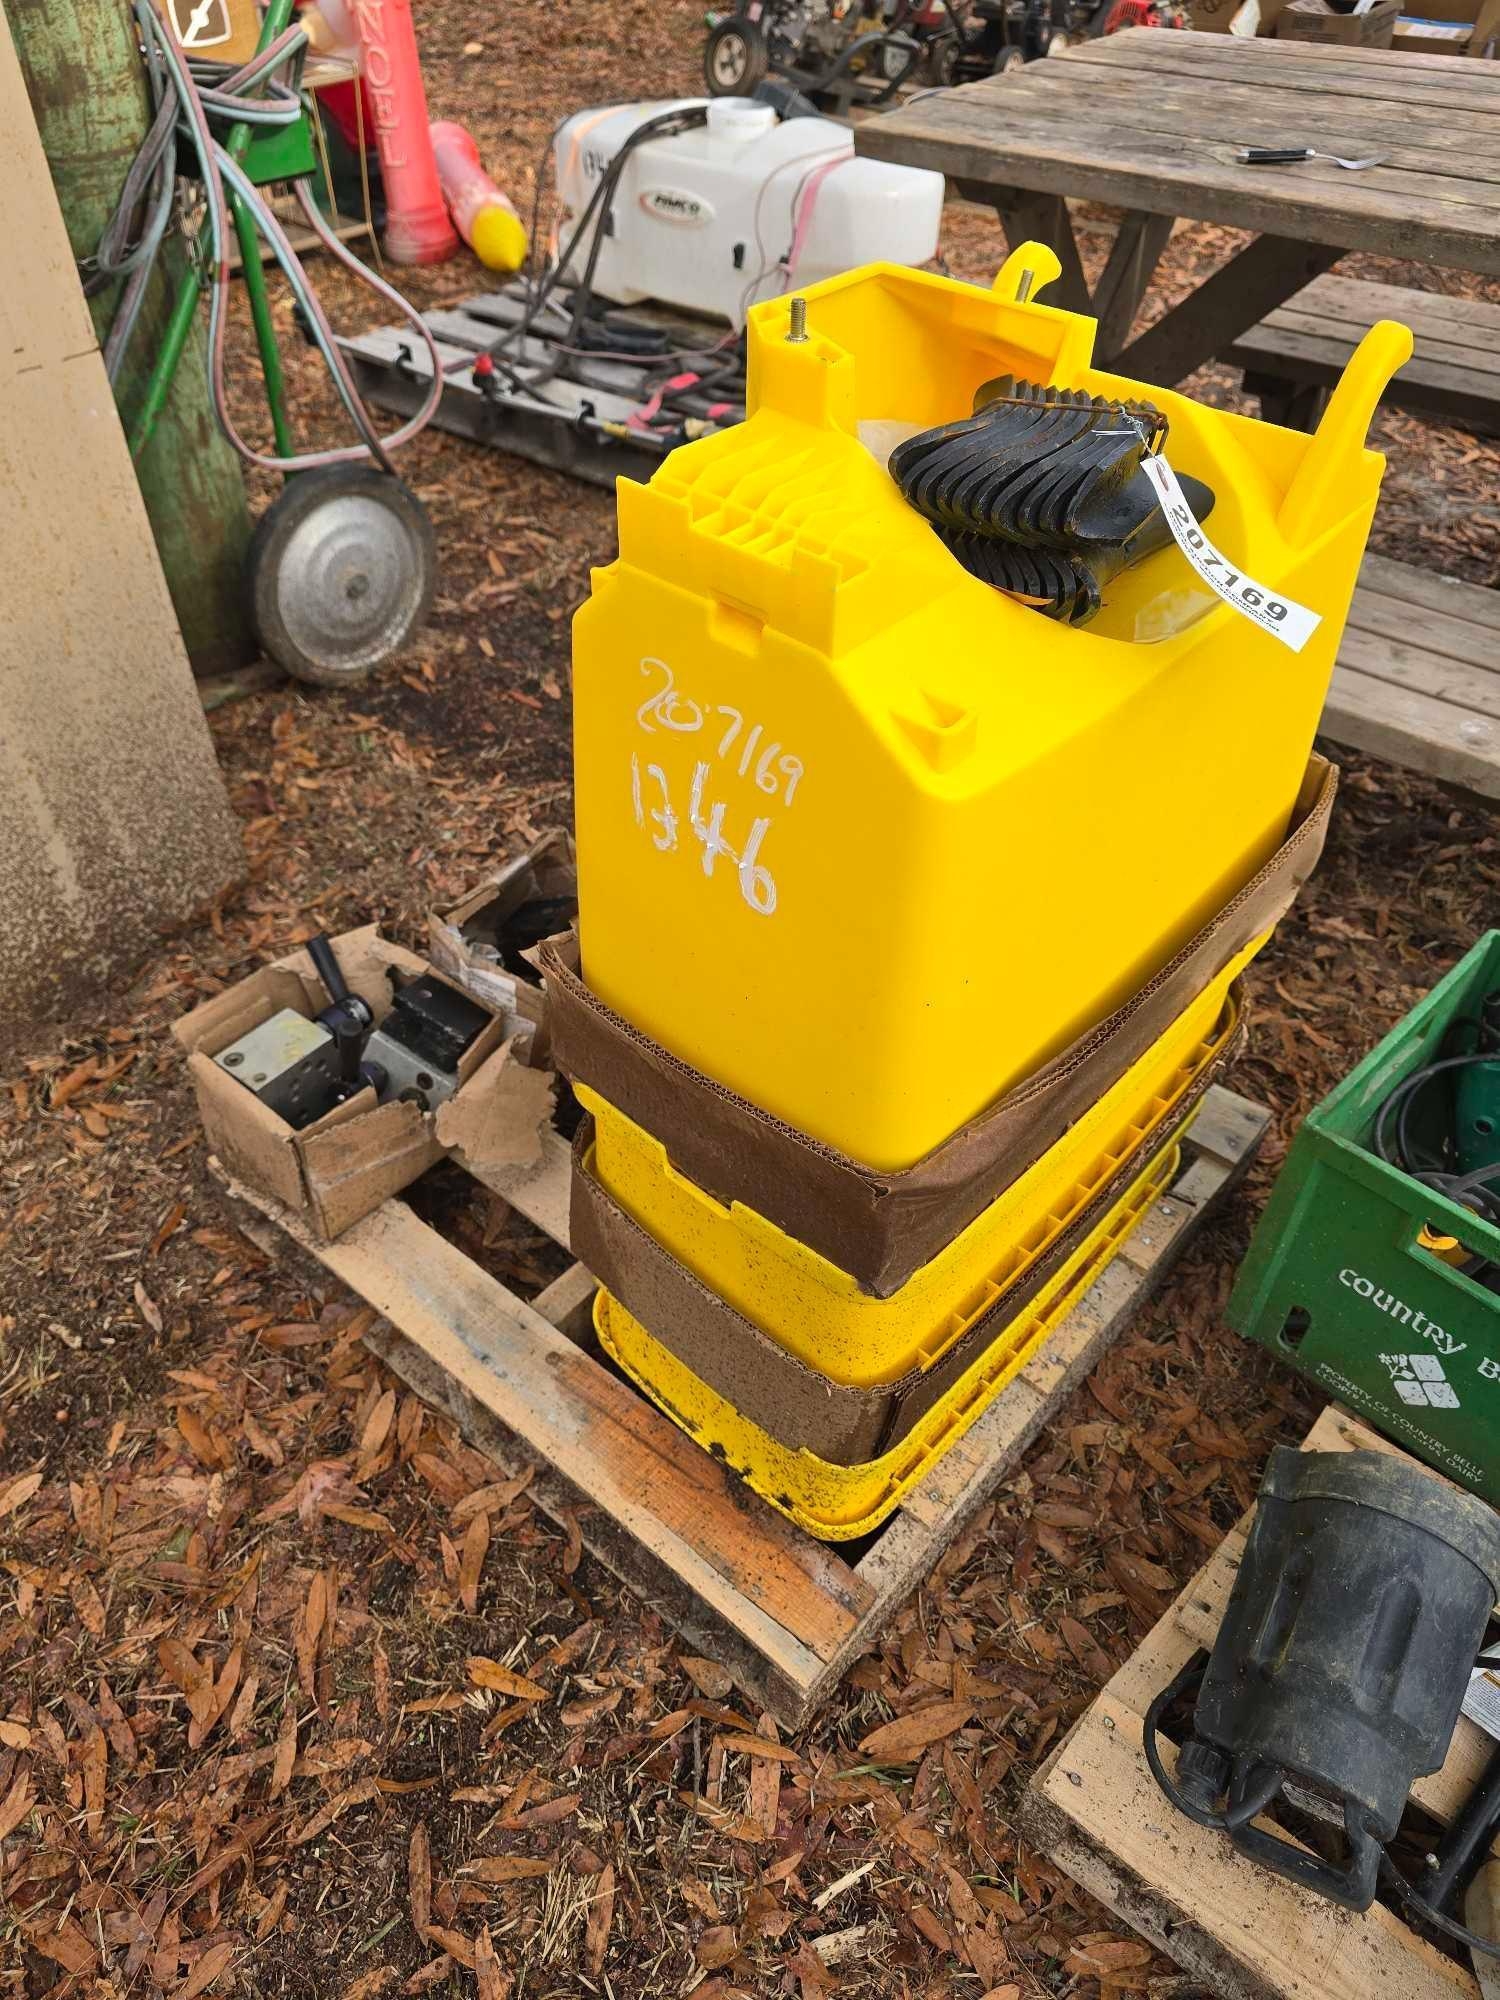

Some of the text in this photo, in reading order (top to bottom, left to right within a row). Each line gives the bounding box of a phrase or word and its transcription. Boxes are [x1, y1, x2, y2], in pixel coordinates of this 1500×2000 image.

[356, 1, 407, 168] NOEL
[1171, 504, 1288, 622] 207169
[637, 657, 804, 807] 207169
[1319, 1362, 1372, 1401] PROPERTY
[1392, 1412, 1450, 1454] COUNTRY
[1452, 1453, 1486, 1477] BELLE
[1446, 1457, 1484, 1484] DAIRY
